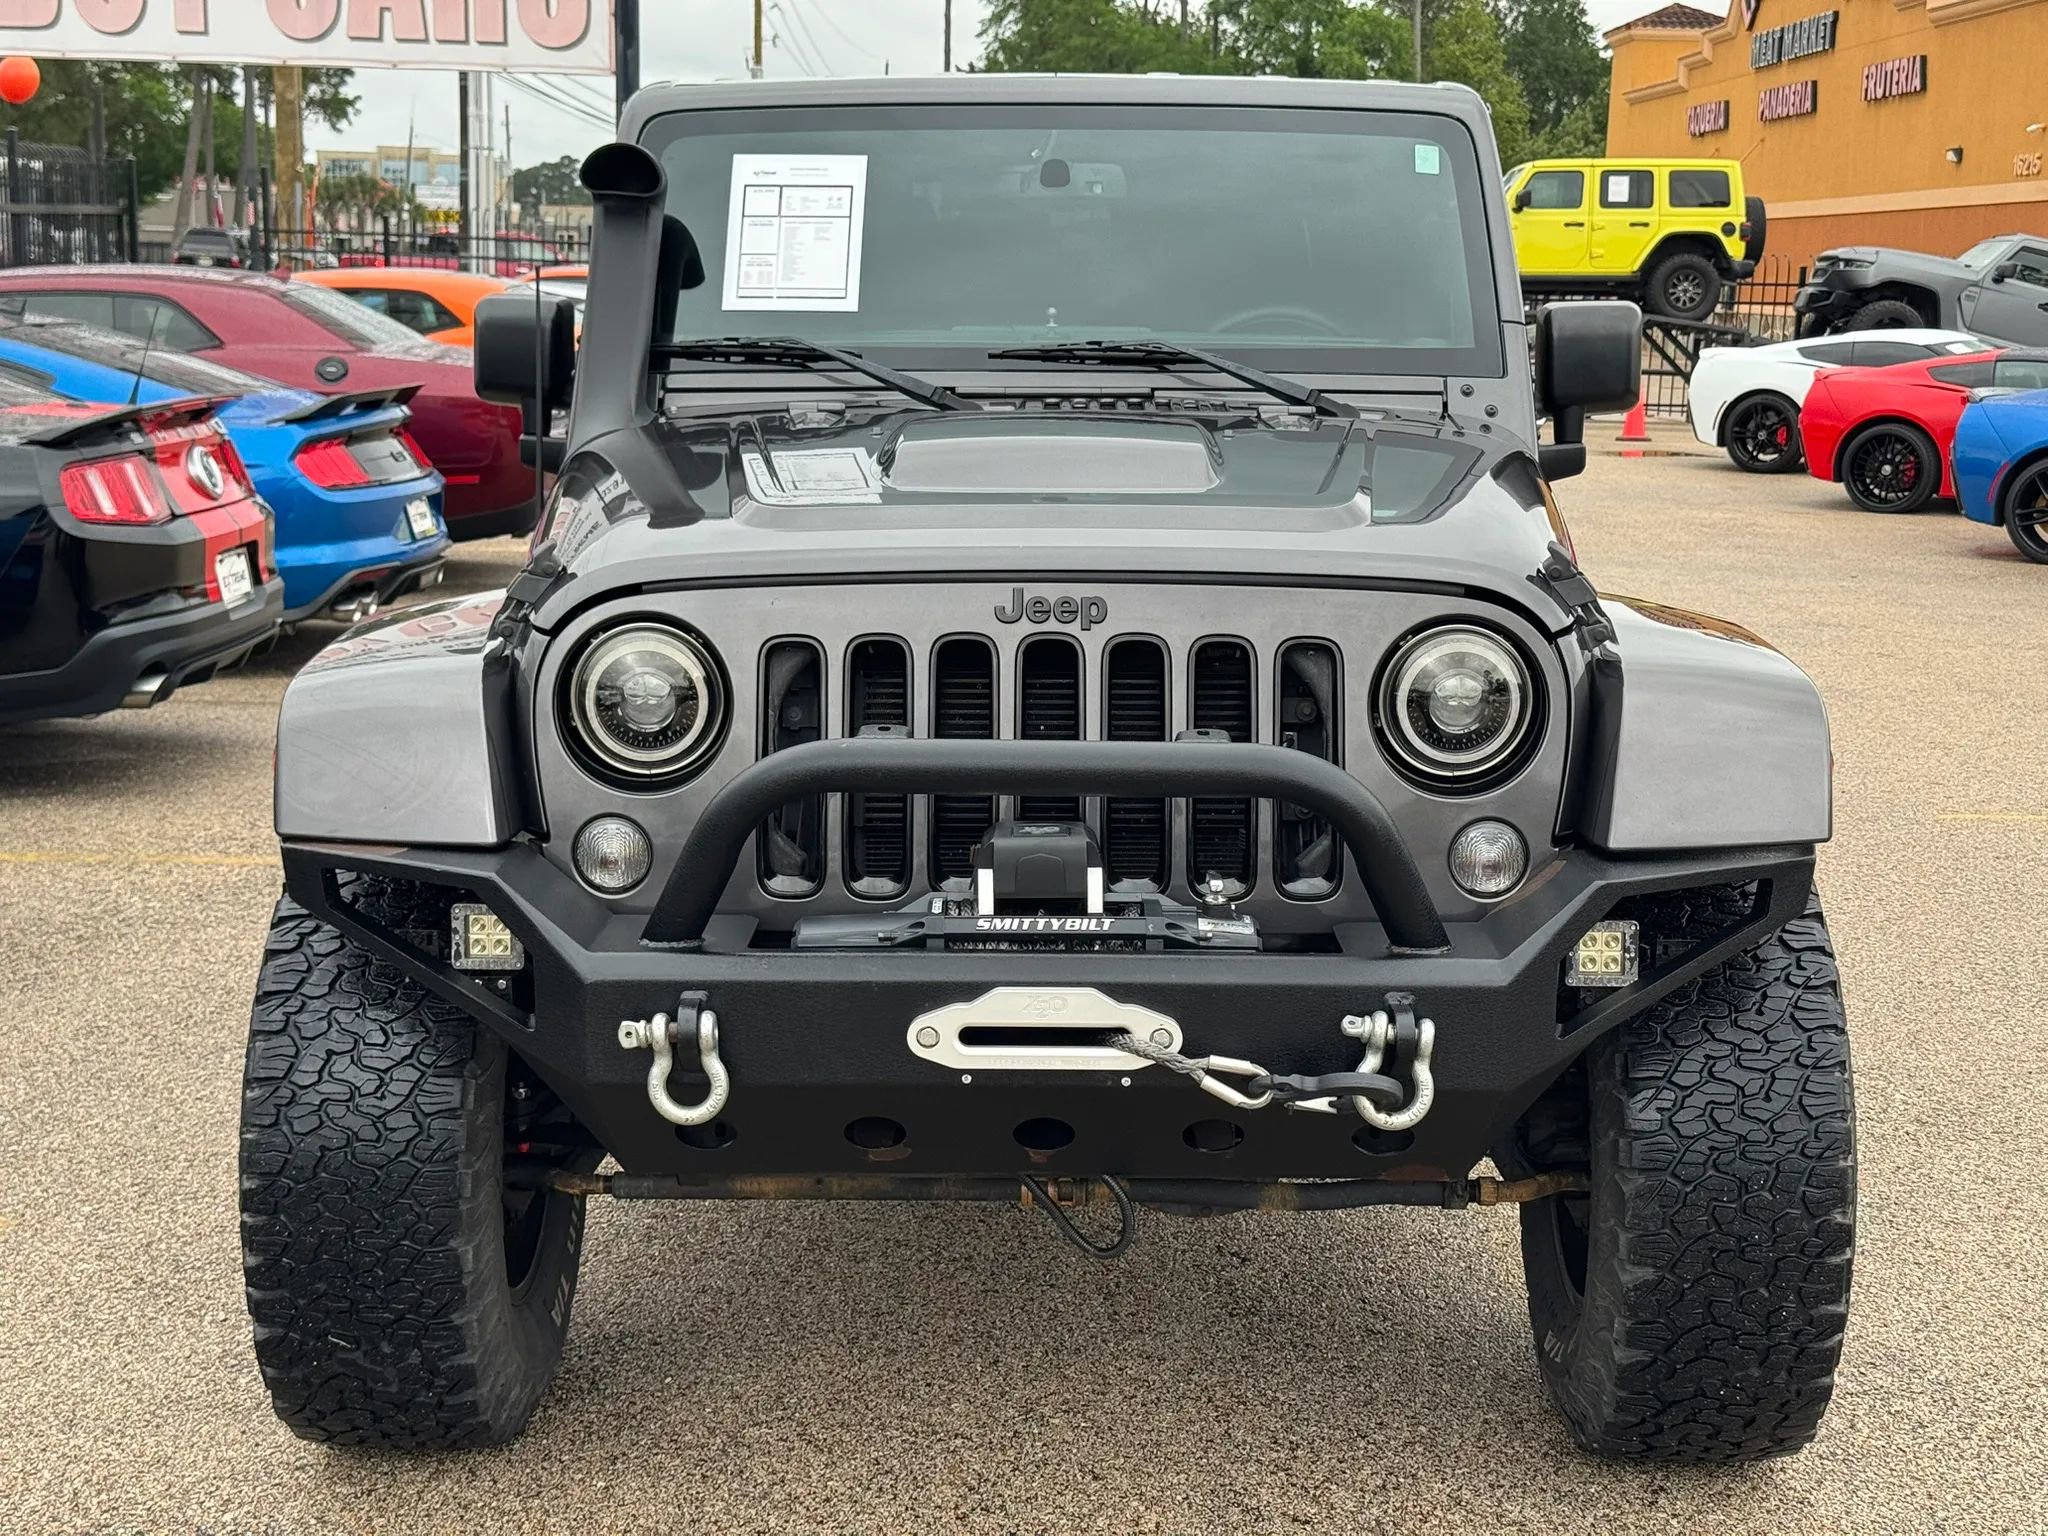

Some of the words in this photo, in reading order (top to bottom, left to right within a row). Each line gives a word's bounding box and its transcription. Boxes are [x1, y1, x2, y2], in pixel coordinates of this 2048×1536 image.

[1752, 28, 1781, 69] MEAT
[1781, 11, 1837, 61] MARKET
[1861, 55, 1925, 102] FRUTERIA
[1686, 100, 1727, 136] TAQUERIA
[1758, 80, 1815, 122] PANADERIA
[2012, 152, 2042, 177] 16215
[994, 587, 1108, 631] Jeep
[976, 917, 1115, 931] SMITTYBILT
